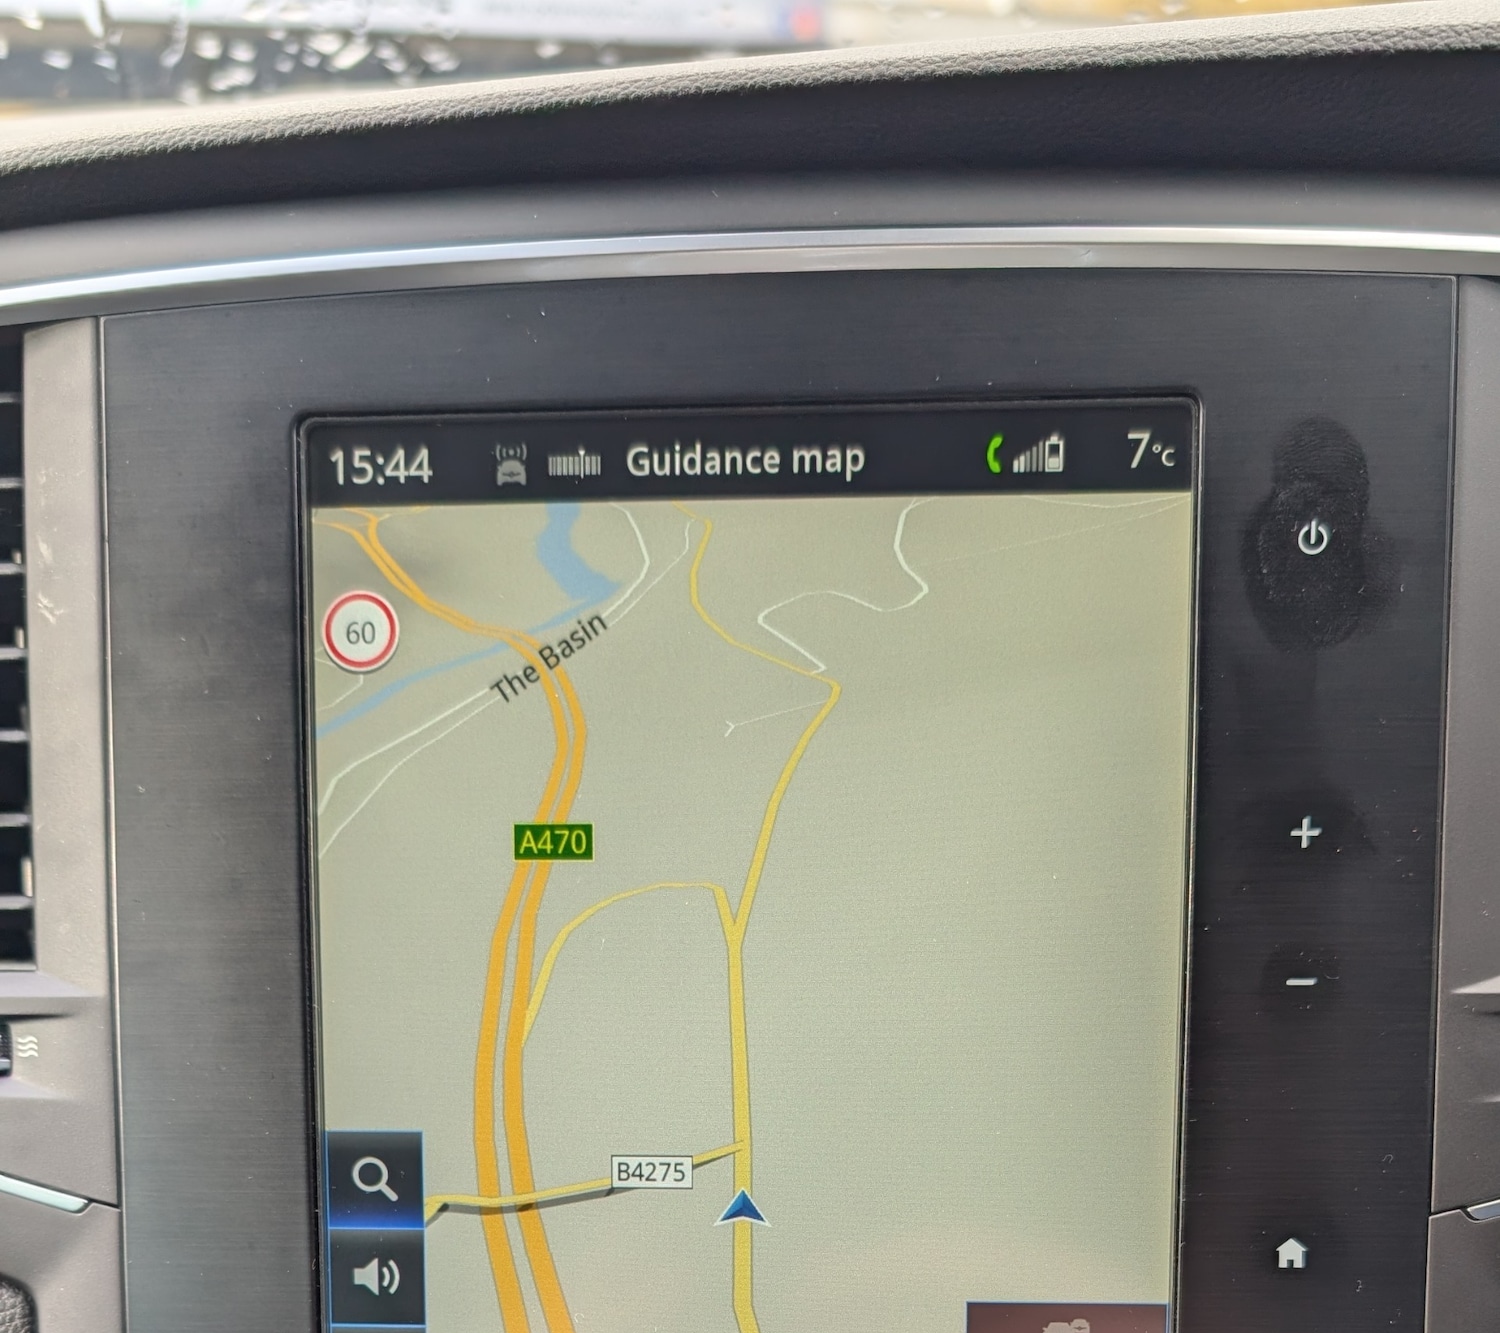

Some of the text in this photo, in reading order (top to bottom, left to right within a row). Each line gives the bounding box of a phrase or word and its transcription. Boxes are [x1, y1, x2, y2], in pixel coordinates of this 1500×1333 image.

[328, 447, 433, 485] 15:44
[625, 443, 866, 483] Guidance map
[344, 620, 377, 646] 60
[490, 611, 608, 705] The Basin
[518, 828, 588, 857] A470
[616, 1159, 688, 1185] B4275
